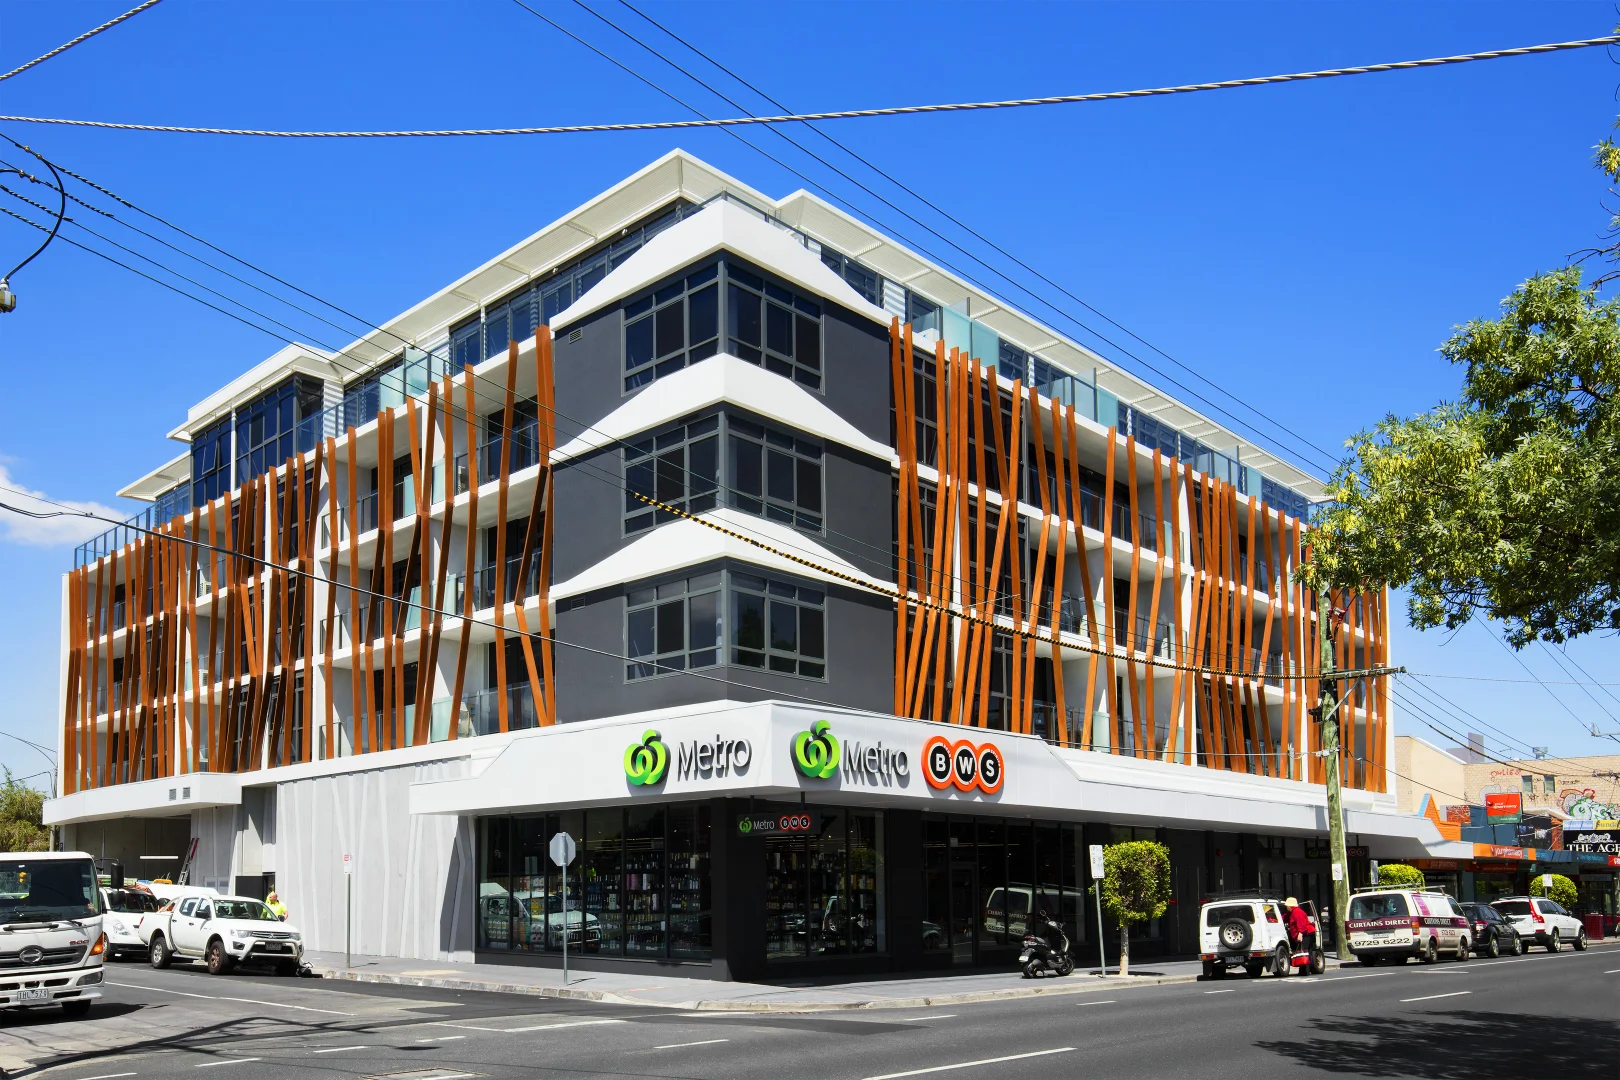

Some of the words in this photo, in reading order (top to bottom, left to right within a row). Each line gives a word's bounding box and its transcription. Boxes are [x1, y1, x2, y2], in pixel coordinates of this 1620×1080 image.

[678, 733, 752, 776] Metro
[843, 740, 909, 777] Metro
[753, 819, 775, 830] Metro
[1566, 843, 1594, 853] THE
[1348, 921, 1383, 929] CURTAINS
[1385, 919, 1410, 927] DIRECT
[1383, 937, 1411, 945] 6222
